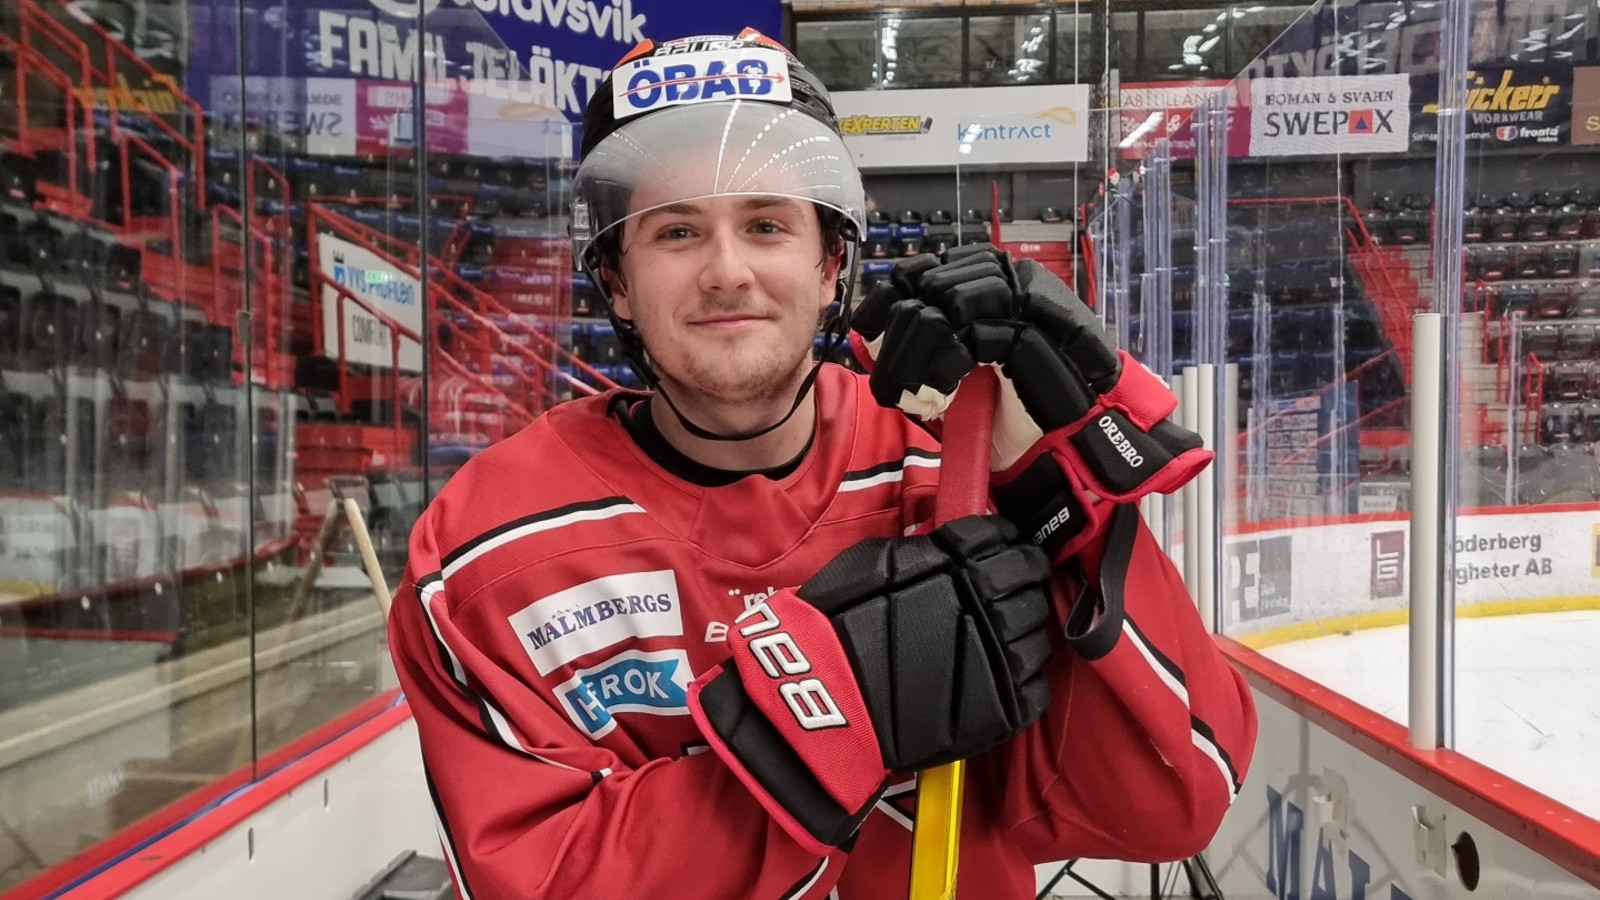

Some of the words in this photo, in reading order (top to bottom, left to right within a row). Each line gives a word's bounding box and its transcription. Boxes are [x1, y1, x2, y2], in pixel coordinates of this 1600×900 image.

[1327, 93, 1337, 103] &
[1342, 91, 1394, 103] SVAHN
[1421, 70, 1560, 113] ickers
[840, 115, 921, 133] EXPERTEN
[1472, 111, 1544, 125] WORKWEAR
[1098, 415, 1144, 468] OREBRO
[1453, 532, 1542, 553] öderberg
[1453, 560, 1520, 585] gheter
[1524, 558, 1553, 576] AB
[526, 593, 672, 651] MALMBERGS
